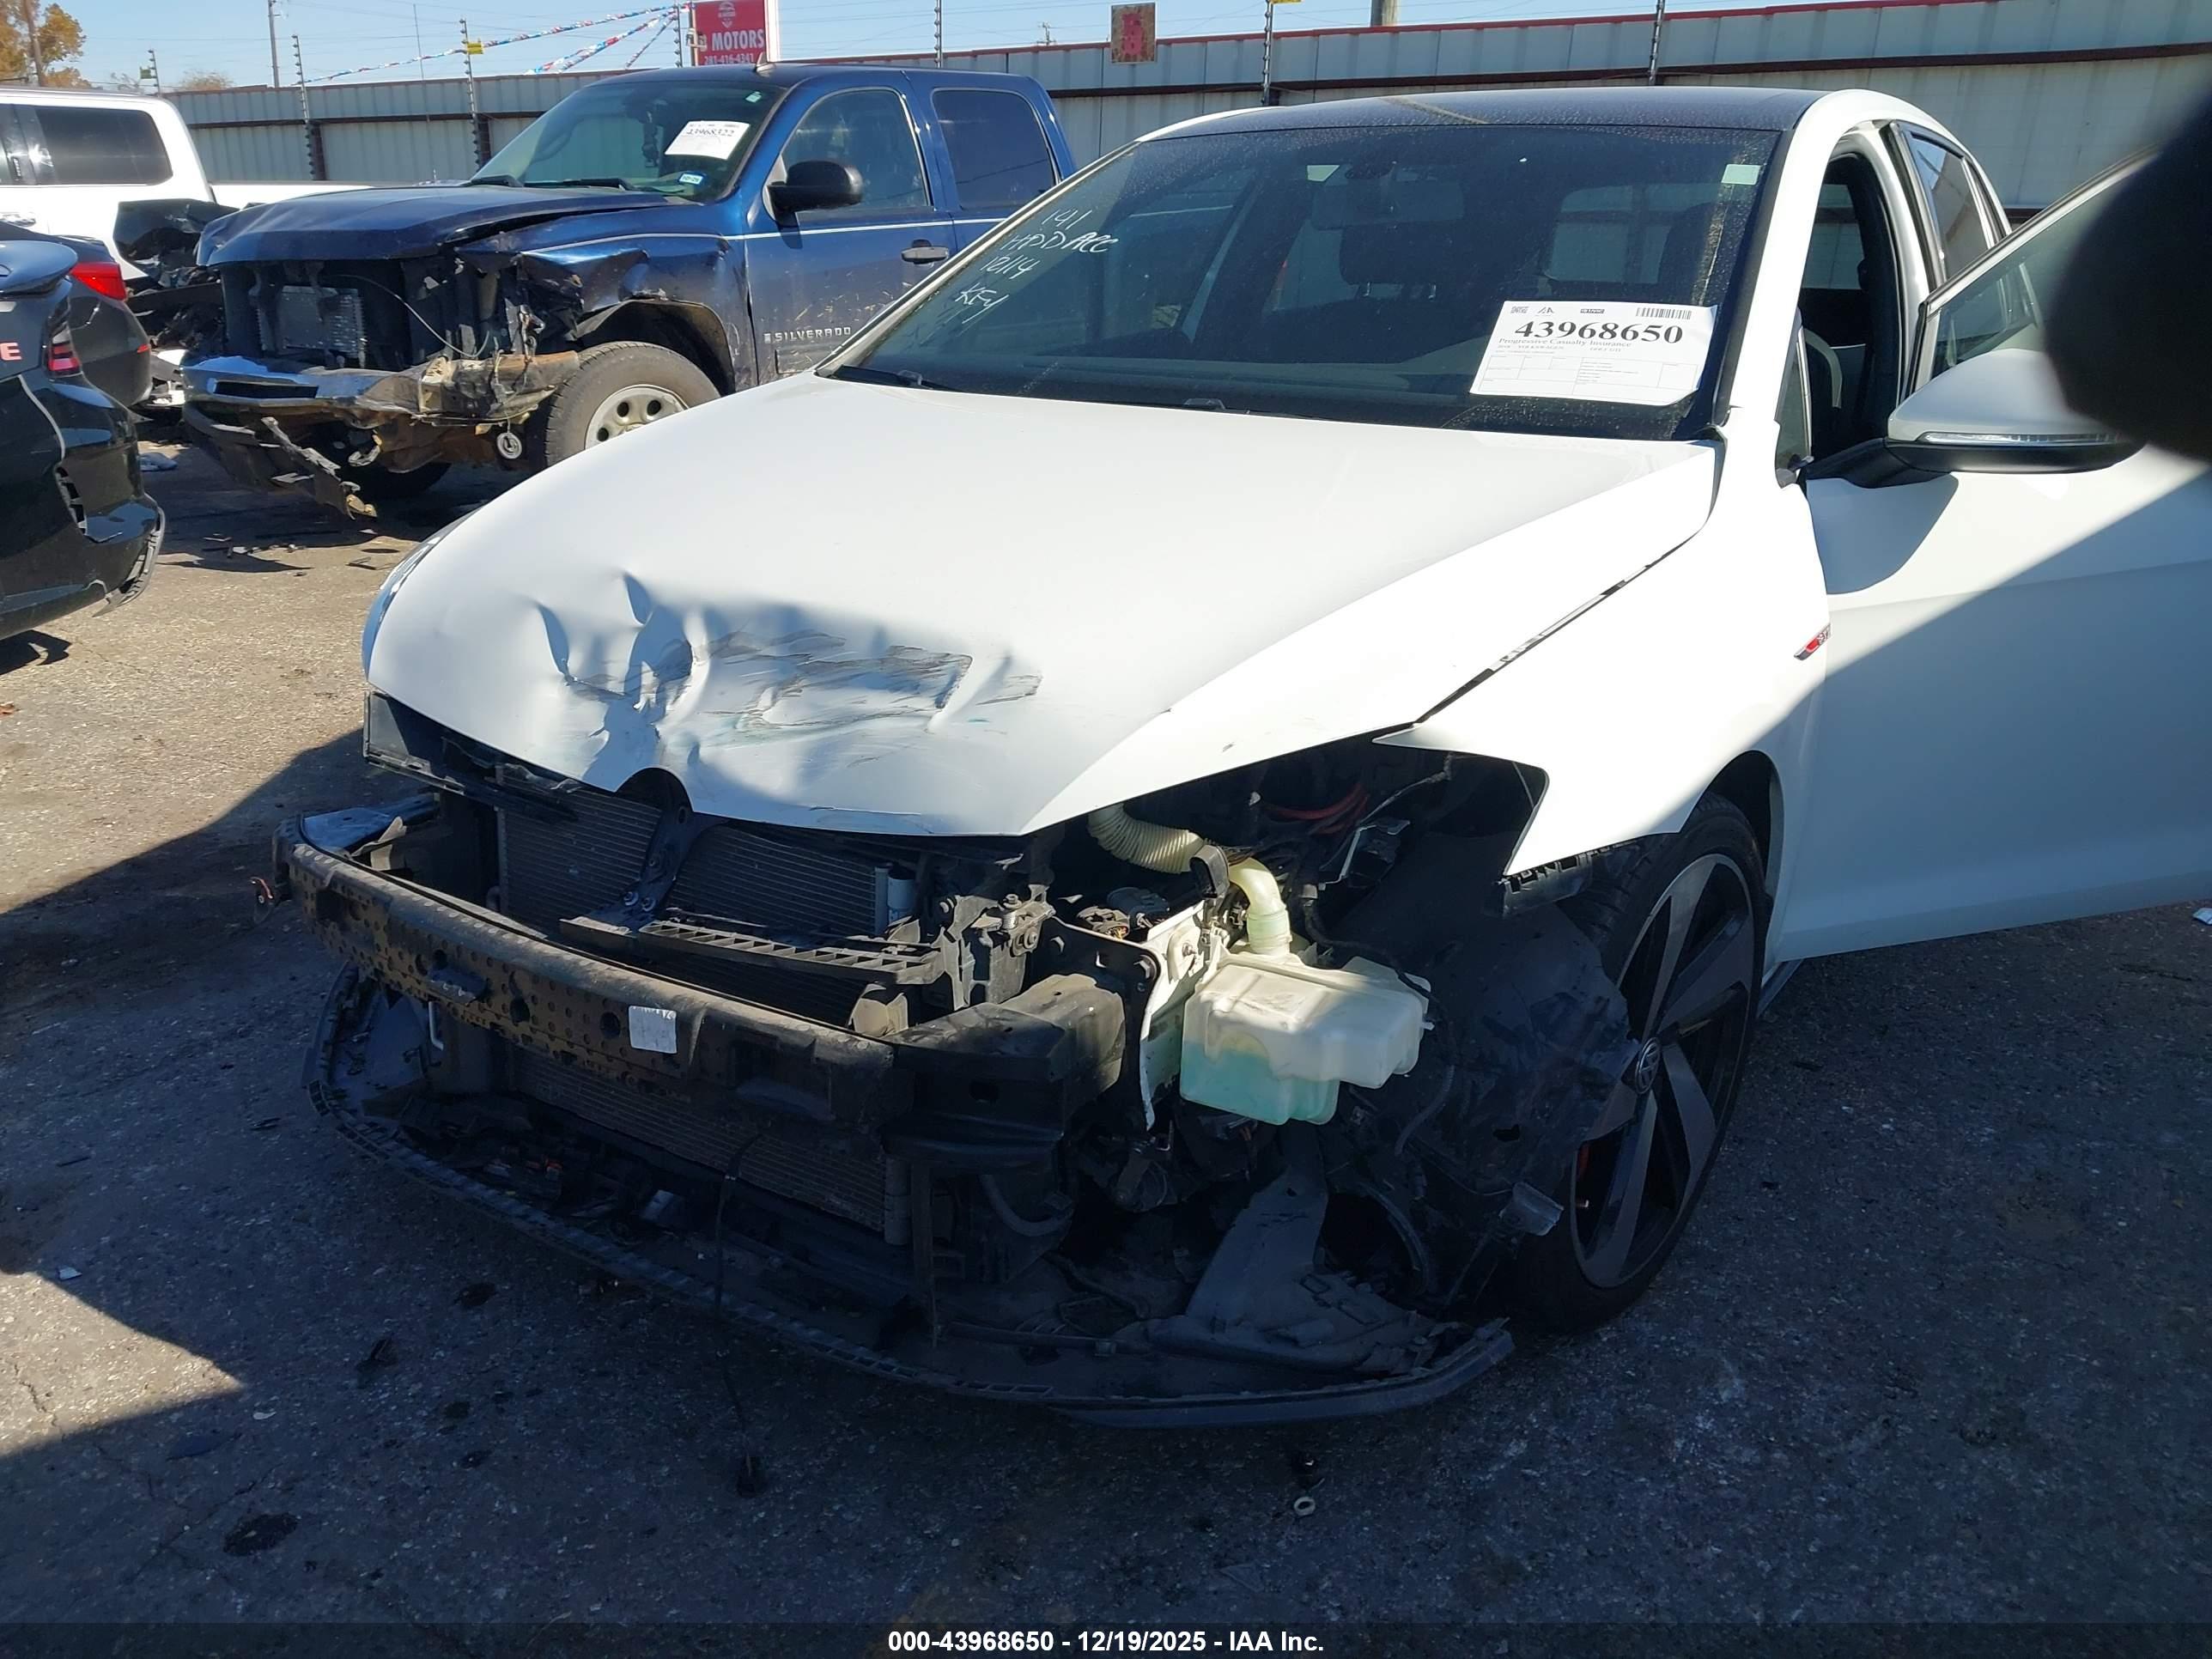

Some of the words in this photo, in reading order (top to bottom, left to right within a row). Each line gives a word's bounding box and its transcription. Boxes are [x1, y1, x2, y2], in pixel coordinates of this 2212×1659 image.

[711, 28, 765, 52] MOTORS
[775, 327, 851, 342] SILVERADO
[1515, 320, 1683, 344] 43968650
[1498, 337, 1549, 346] Progressive
[1549, 338, 1587, 347] Casualty
